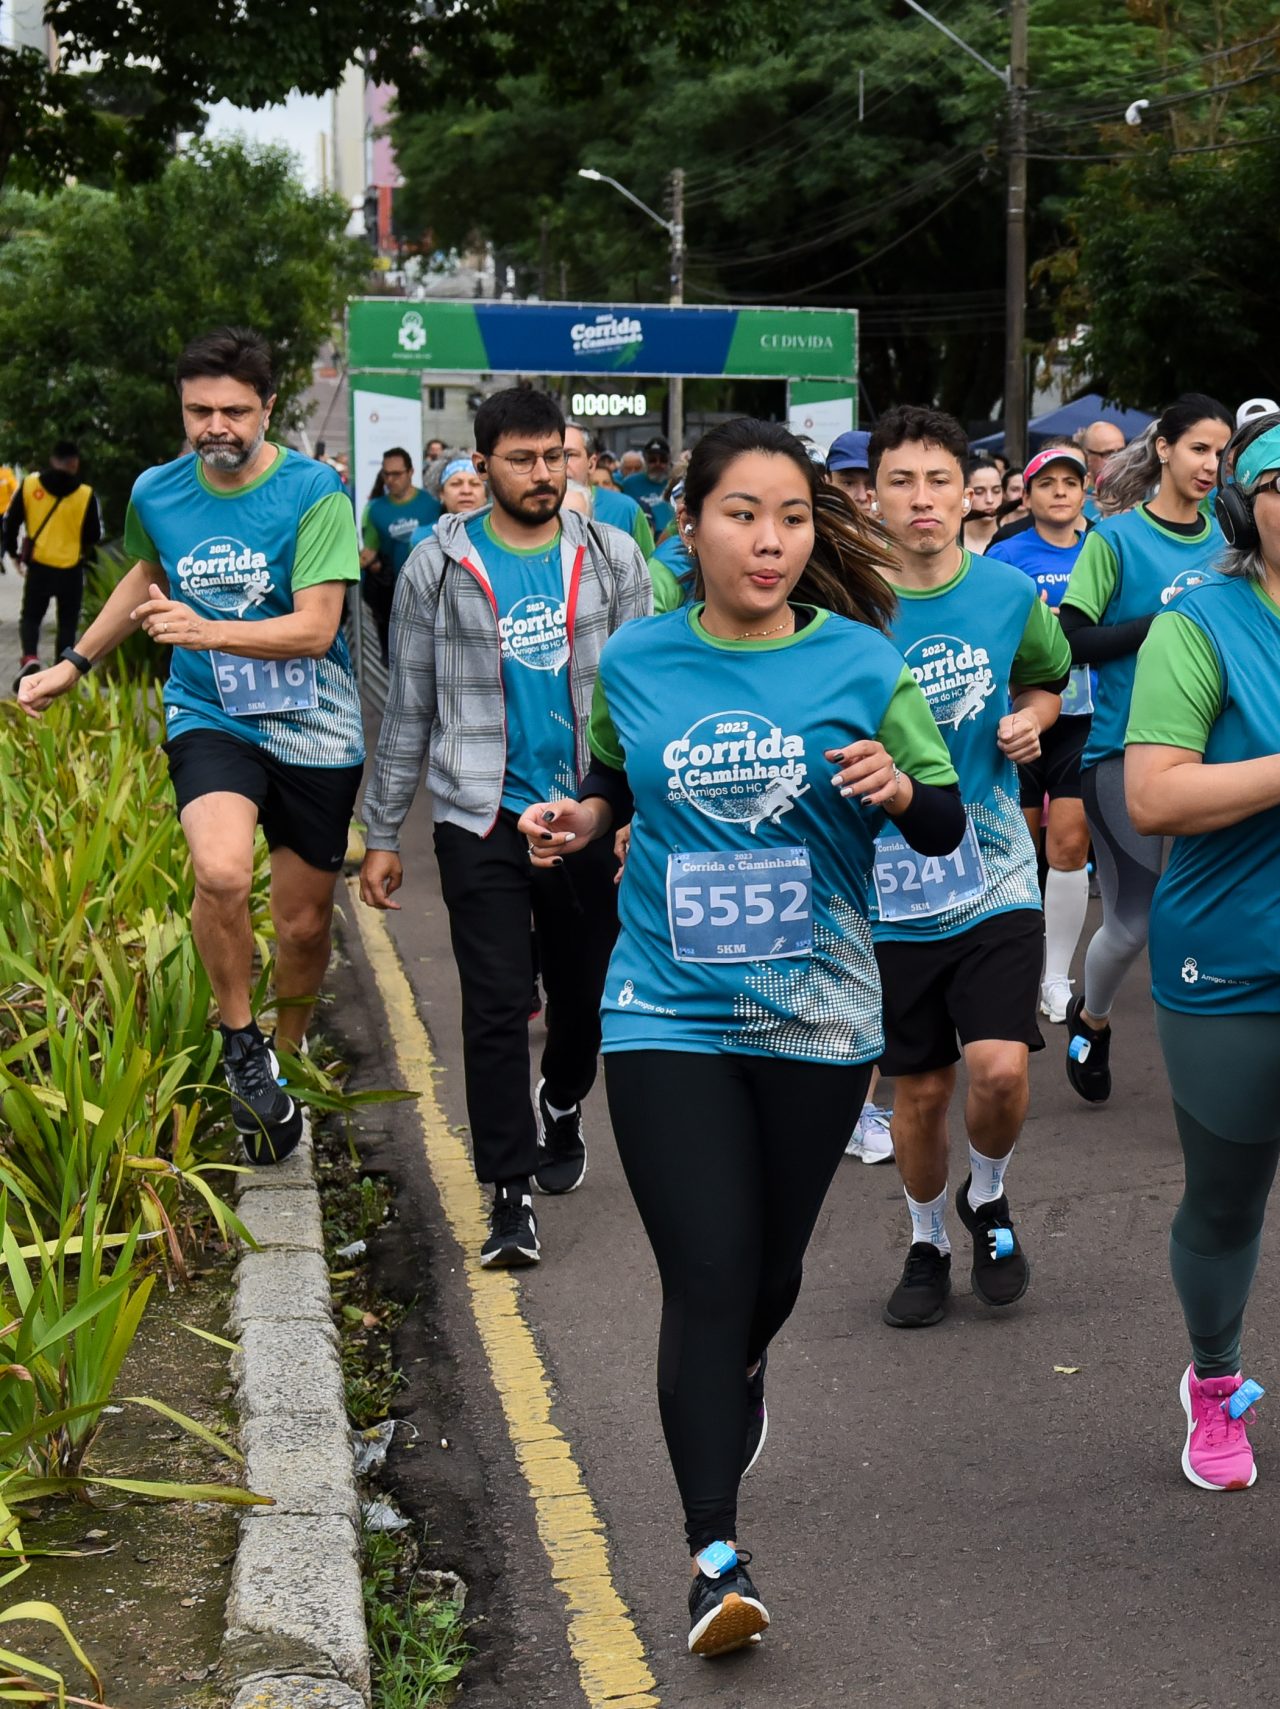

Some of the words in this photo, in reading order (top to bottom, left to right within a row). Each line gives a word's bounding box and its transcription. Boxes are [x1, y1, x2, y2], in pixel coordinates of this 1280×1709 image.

[570, 317, 641, 341] Corrida
[760, 334, 834, 348] CEDIVIDA
[209, 544, 231, 554] 2023
[176, 548, 267, 577] Corrida
[190, 569, 271, 589] Caminhada
[526, 602, 545, 612] 2023
[515, 646, 540, 655] Amigos
[541, 642, 549, 651] do
[550, 640, 561, 649] HC
[922, 643, 946, 657] 2023
[218, 659, 305, 693] 5116
[940, 693, 950, 701] do
[951, 688, 963, 697] HC
[715, 721, 749, 735] 2023
[663, 728, 805, 770] Corrida
[667, 775, 680, 790] e
[684, 759, 808, 786] Caminhada
[667, 790, 688, 801] dos
[688, 786, 728, 799] Amigos
[731, 784, 744, 794] do
[746, 782, 762, 793] HC
[878, 842, 905, 852] Corrida
[682, 862, 725, 872] Corrida
[738, 857, 807, 871] Caminhada
[876, 848, 966, 894] 5241
[674, 881, 809, 926] 5552
[910, 902, 930, 912] 5KM
[717, 944, 747, 954] 5KM
[1200, 973, 1226, 984] Amigos
[632, 998, 655, 1011] Amigos
[665, 1008, 677, 1016] HC
